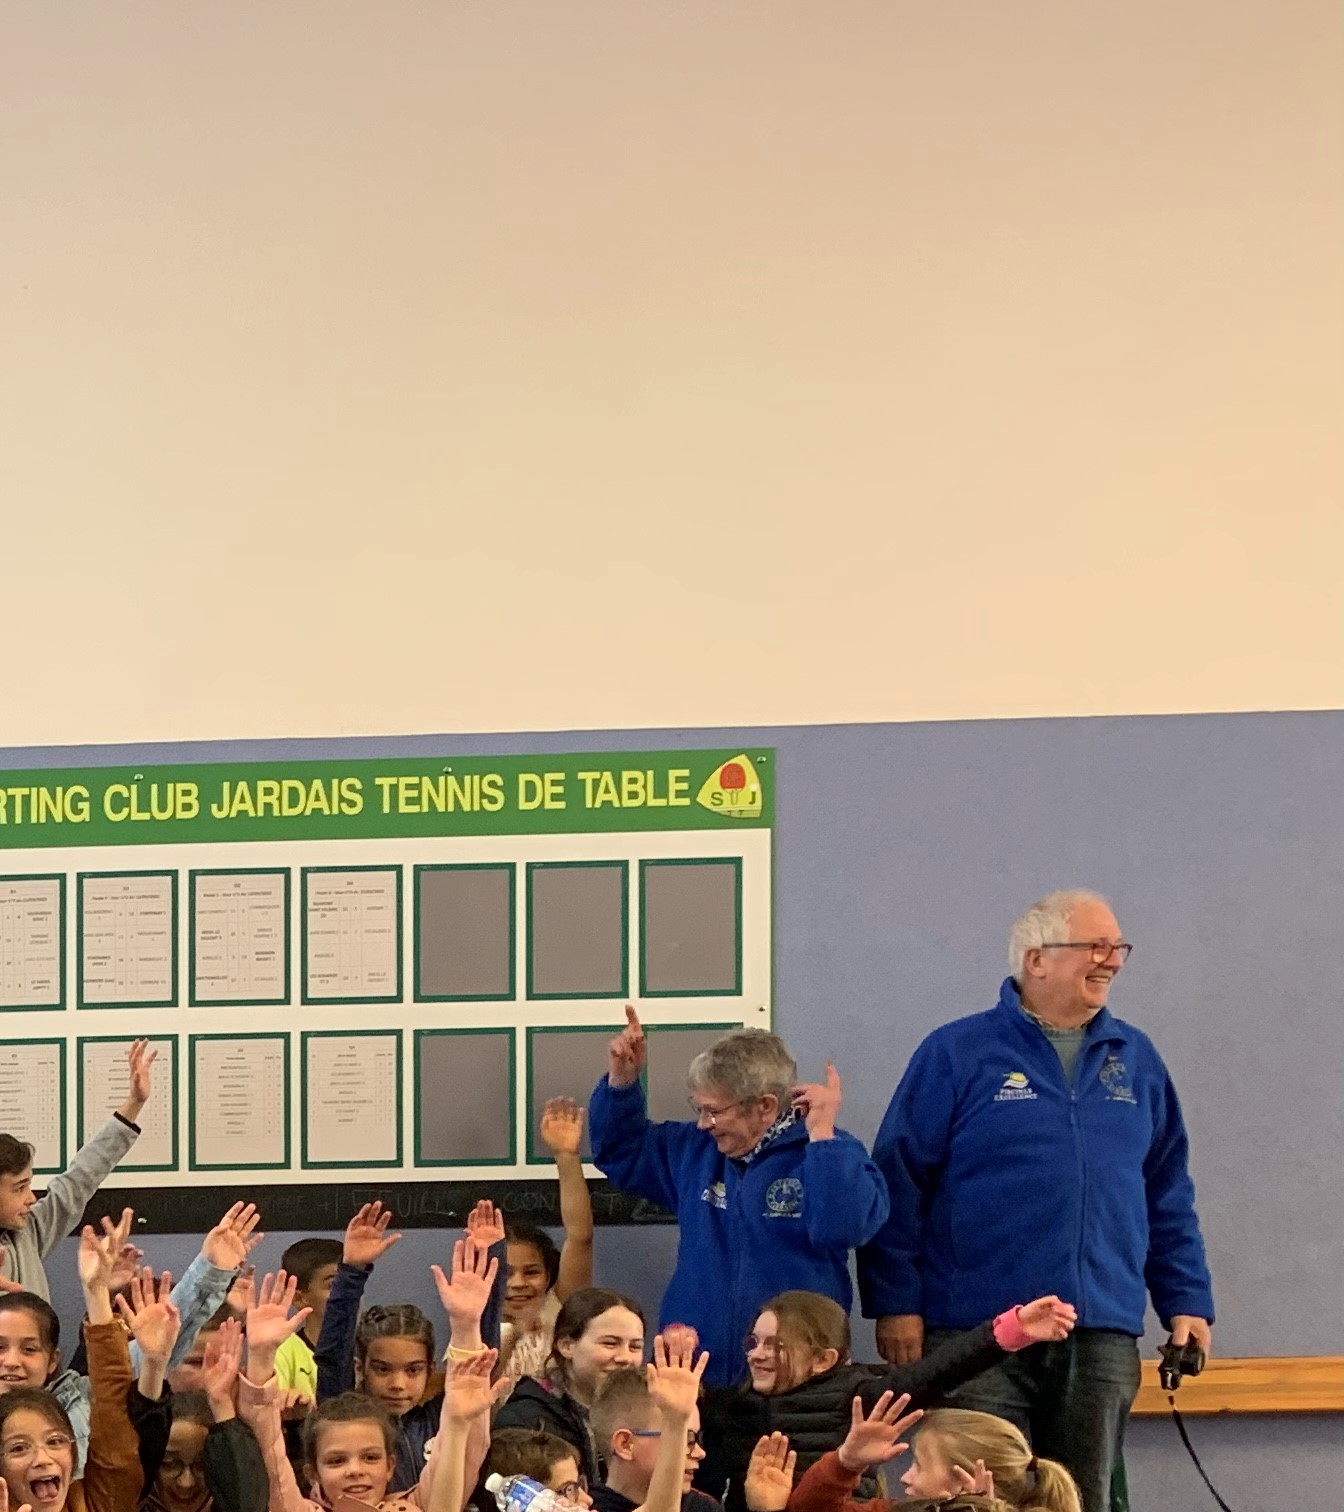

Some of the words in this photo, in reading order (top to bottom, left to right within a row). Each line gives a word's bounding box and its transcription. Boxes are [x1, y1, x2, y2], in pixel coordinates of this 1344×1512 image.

[103, 782, 200, 821] CLUB
[211, 777, 364, 819] JARDAIS
[374, 772, 505, 814] TENNIS
[518, 772, 566, 810] DE
[577, 768, 691, 808] TABLE
